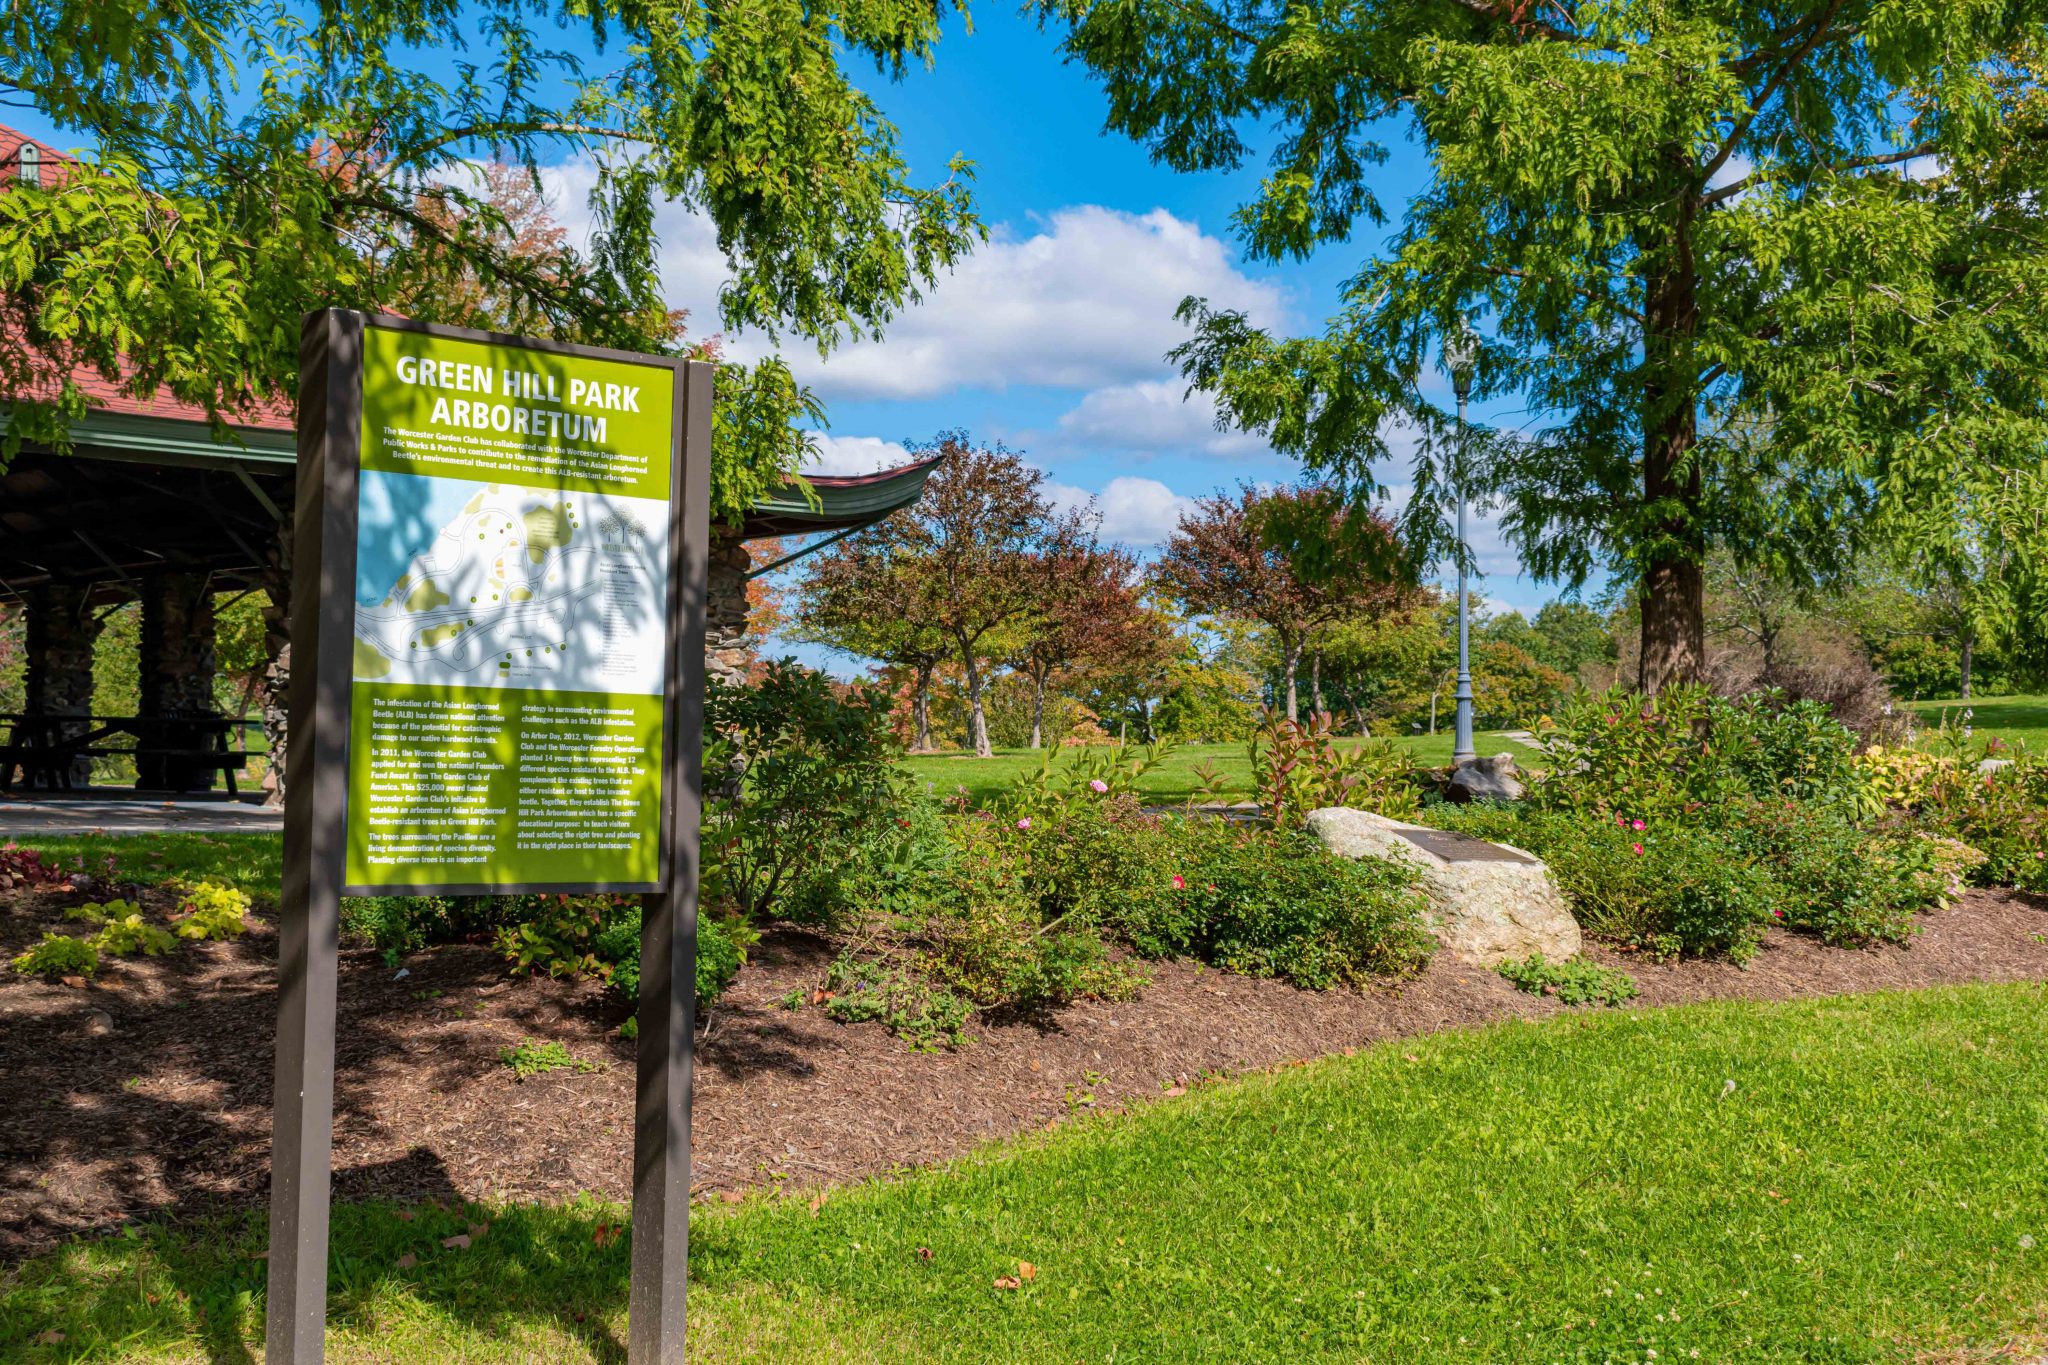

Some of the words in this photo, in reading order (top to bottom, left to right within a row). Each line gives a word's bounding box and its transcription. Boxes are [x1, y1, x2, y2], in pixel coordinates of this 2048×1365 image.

[395, 356, 493, 394] GREEN
[502, 369, 560, 403] HILL
[569, 378, 640, 413] PARK
[430, 396, 607, 444] ARBORETUM
[383, 426, 396, 435] The
[398, 427, 433, 439] Worcester
[435, 432, 461, 442] Garden
[463, 435, 478, 444] Club
[480, 437, 492, 446] has
[493, 438, 536, 451] collaborated
[536, 443, 552, 452] with
[554, 445, 565, 454] the
[566, 447, 599, 458] Worcester
[600, 451, 639, 464] Department
[640, 455, 647, 463] of
[383, 437, 404, 447] Public
[406, 440, 428, 450] Works
[430, 442, 436, 450] &
[437, 443, 456, 453] Parks
[458, 445, 466, 454] to
[467, 446, 503, 458] contribute
[505, 451, 512, 459] to
[514, 452, 525, 460] the
[527, 453, 568, 465] remediation
[569, 458, 576, 466] of
[578, 459, 589, 467] the
[590, 460, 608, 469] Asian
[609, 462, 647, 475] Longhorned
[392, 450, 420, 460] Beetle's
[422, 453, 474, 466] environmental
[475, 459, 496, 468] threat
[498, 461, 511, 470] and
[512, 463, 520, 471] to
[521, 464, 543, 473] create
[544, 466, 557, 475] this
[558, 468, 601, 480] ALB-resistant
[603, 473, 639, 484] arboretum.
[373, 698, 385, 706] The
[386, 699, 422, 707] infestation
[423, 700, 430, 708] of
[430, 700, 442, 708] the
[521, 704, 546, 713] strategy
[373, 710, 394, 718] Beetle
[395, 710, 413, 720] (ALB)
[415, 711, 427, 719] has
[521, 715, 554, 725] challenges
[554, 716, 569, 724] such
[589, 717, 602, 725] ALB
[372, 721, 399, 729] because
[408, 722, 420, 730] the
[421, 722, 450, 732] potential
[372, 732, 398, 742] damage
[399, 733, 406, 741] to
[474, 735, 497, 743] forests.
[520, 731, 529, 739] On
[530, 731, 548, 739] Arbor
[548, 732, 561, 741] Day,
[563, 732, 580, 742] 2012,
[582, 733, 612, 741] Worcester
[520, 742, 535, 750] Club
[535, 742, 547, 750] and
[559, 743, 589, 751] Worcester
[380, 748, 399, 758] 2011,
[413, 749, 446, 757] Worcester
[447, 750, 470, 758] Garden
[472, 750, 486, 758] Club
[520, 753, 543, 763] planted
[519, 764, 546, 772] different
[547, 765, 569, 774] species
[616, 766, 630, 774] ALB.
[632, 767, 644, 776] They
[443, 772, 466, 780] Garden
[416, 783, 444, 792] $25,000
[519, 786, 537, 794] either
[595, 787, 606, 795] the
[479, 795, 486, 803] to
[569, 798, 582, 807] they
[409, 806, 442, 814] arboretum
[529, 808, 544, 816] Park
[421, 817, 438, 825] trees
[447, 817, 466, 825] Green
[517, 819, 554, 827] educational
[368, 832, 381, 840] The
[381, 832, 399, 840] trees
[400, 832, 440, 842] surrounding
[535, 831, 564, 839] selecting
[575, 831, 590, 839] right
[616, 831, 640, 839] planting
[368, 844, 385, 853] living
[443, 844, 468, 853] species
[529, 841, 541, 849] the
[541, 841, 557, 850] right
[557, 841, 574, 850] place
[582, 841, 597, 849] their
[367, 855, 395, 865] Planting
[396, 855, 420, 863] diverse
[420, 855, 438, 863] trees
[455, 855, 487, 864] important
